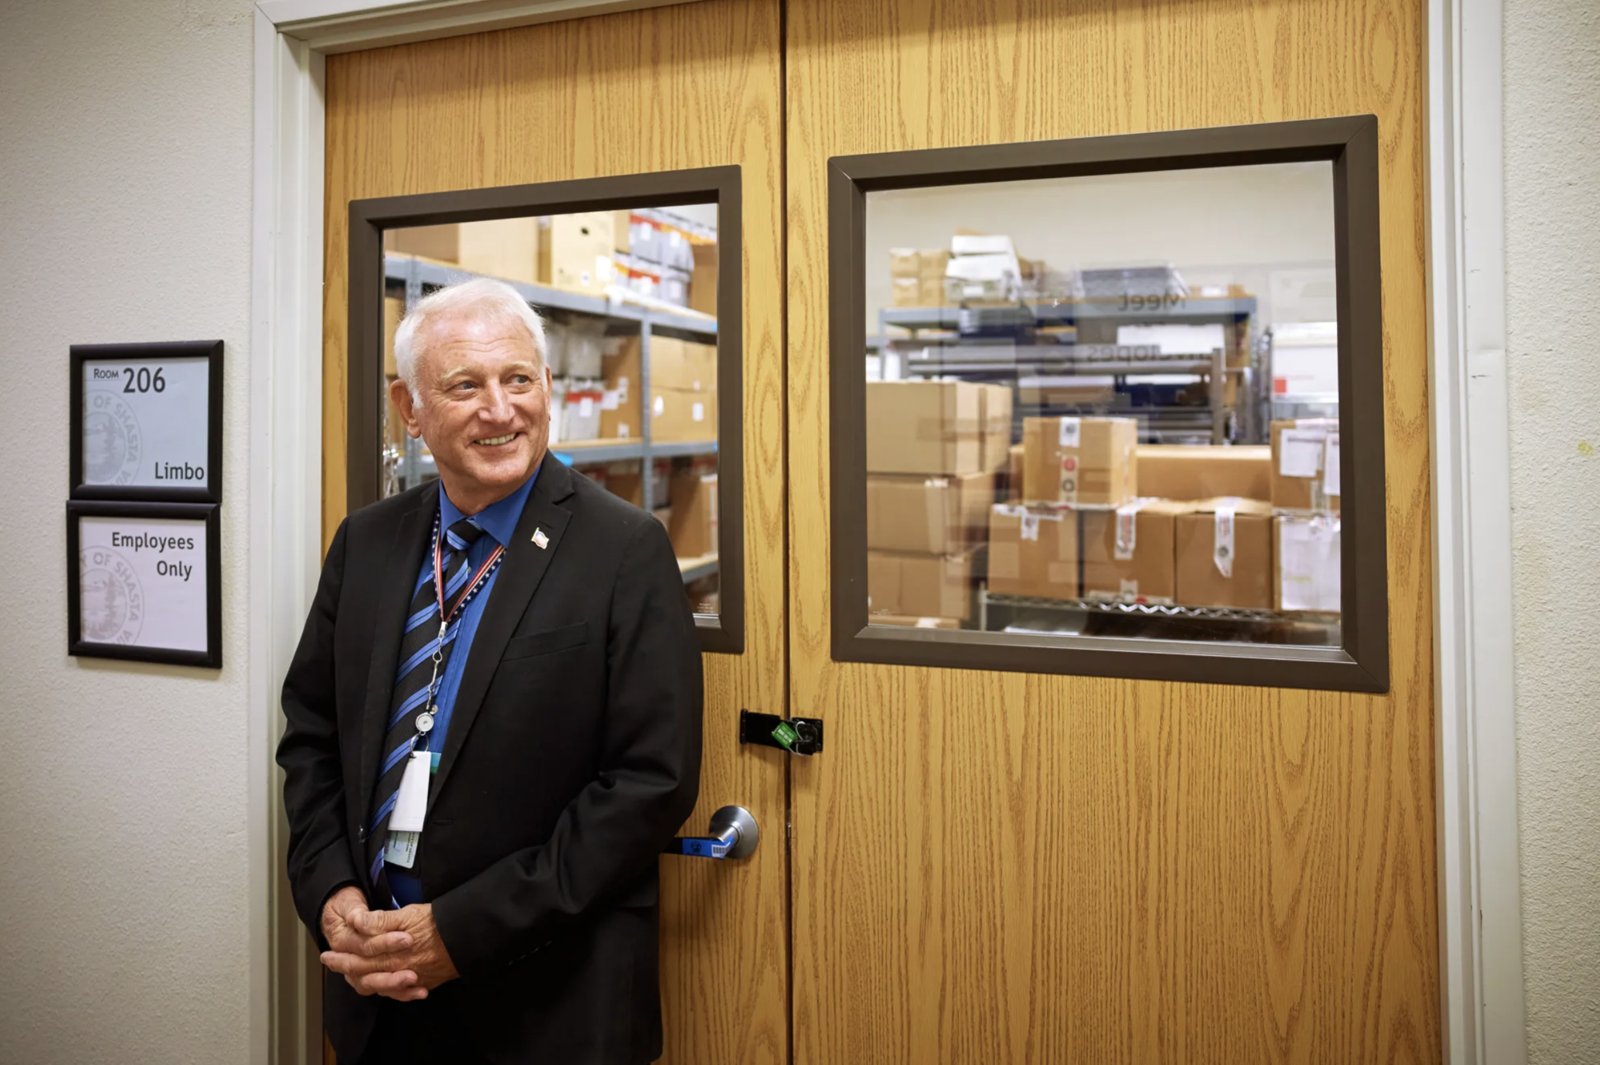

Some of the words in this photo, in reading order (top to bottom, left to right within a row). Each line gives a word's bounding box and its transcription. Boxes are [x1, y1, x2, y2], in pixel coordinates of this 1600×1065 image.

[123, 367, 166, 393] 206
[93, 395, 113, 409] OF
[113, 403, 139, 462] SHASTA
[155, 461, 205, 480] Limbo
[112, 532, 194, 553] Employees
[156, 560, 193, 581] Only
[93, 552, 113, 566] OF
[114, 561, 140, 621] SHASTA
